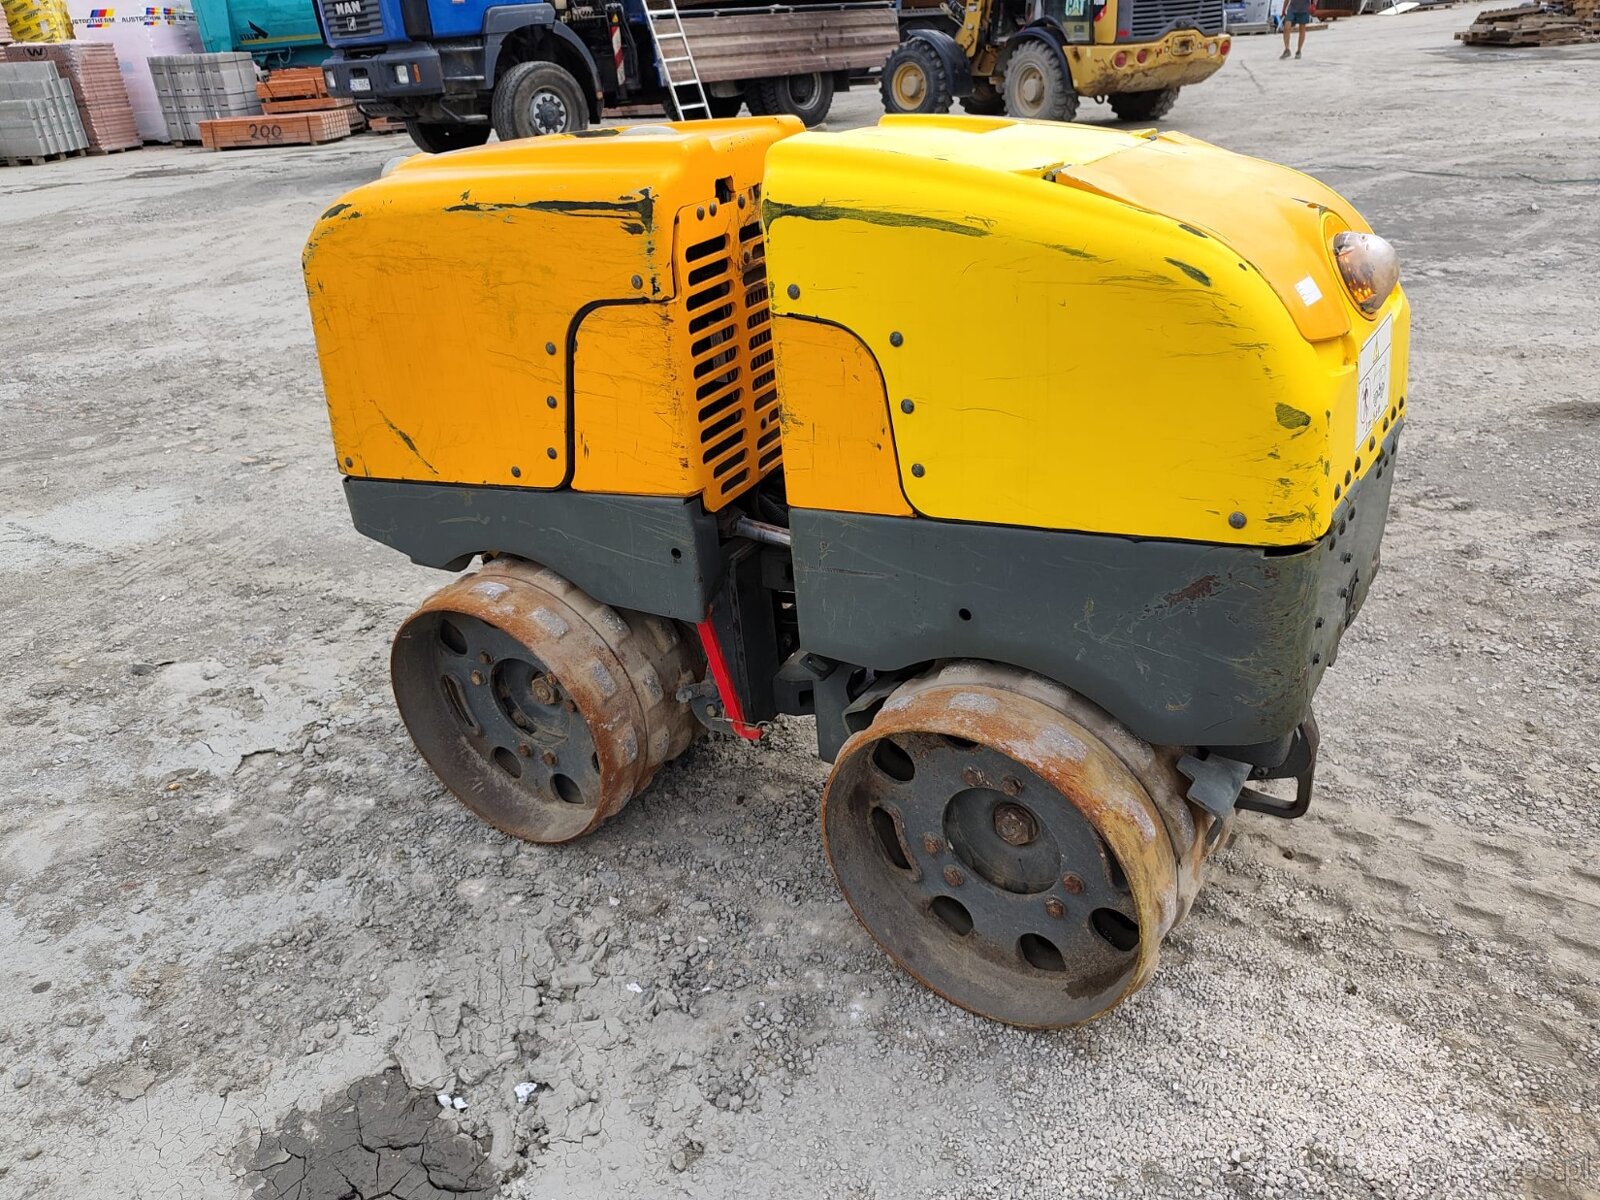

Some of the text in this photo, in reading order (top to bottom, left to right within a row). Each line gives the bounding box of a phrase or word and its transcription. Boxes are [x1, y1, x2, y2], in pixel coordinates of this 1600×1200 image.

[335, 1, 362, 15] MAN
[1065, 0, 1085, 16] CAT
[248, 123, 282, 141] 200
